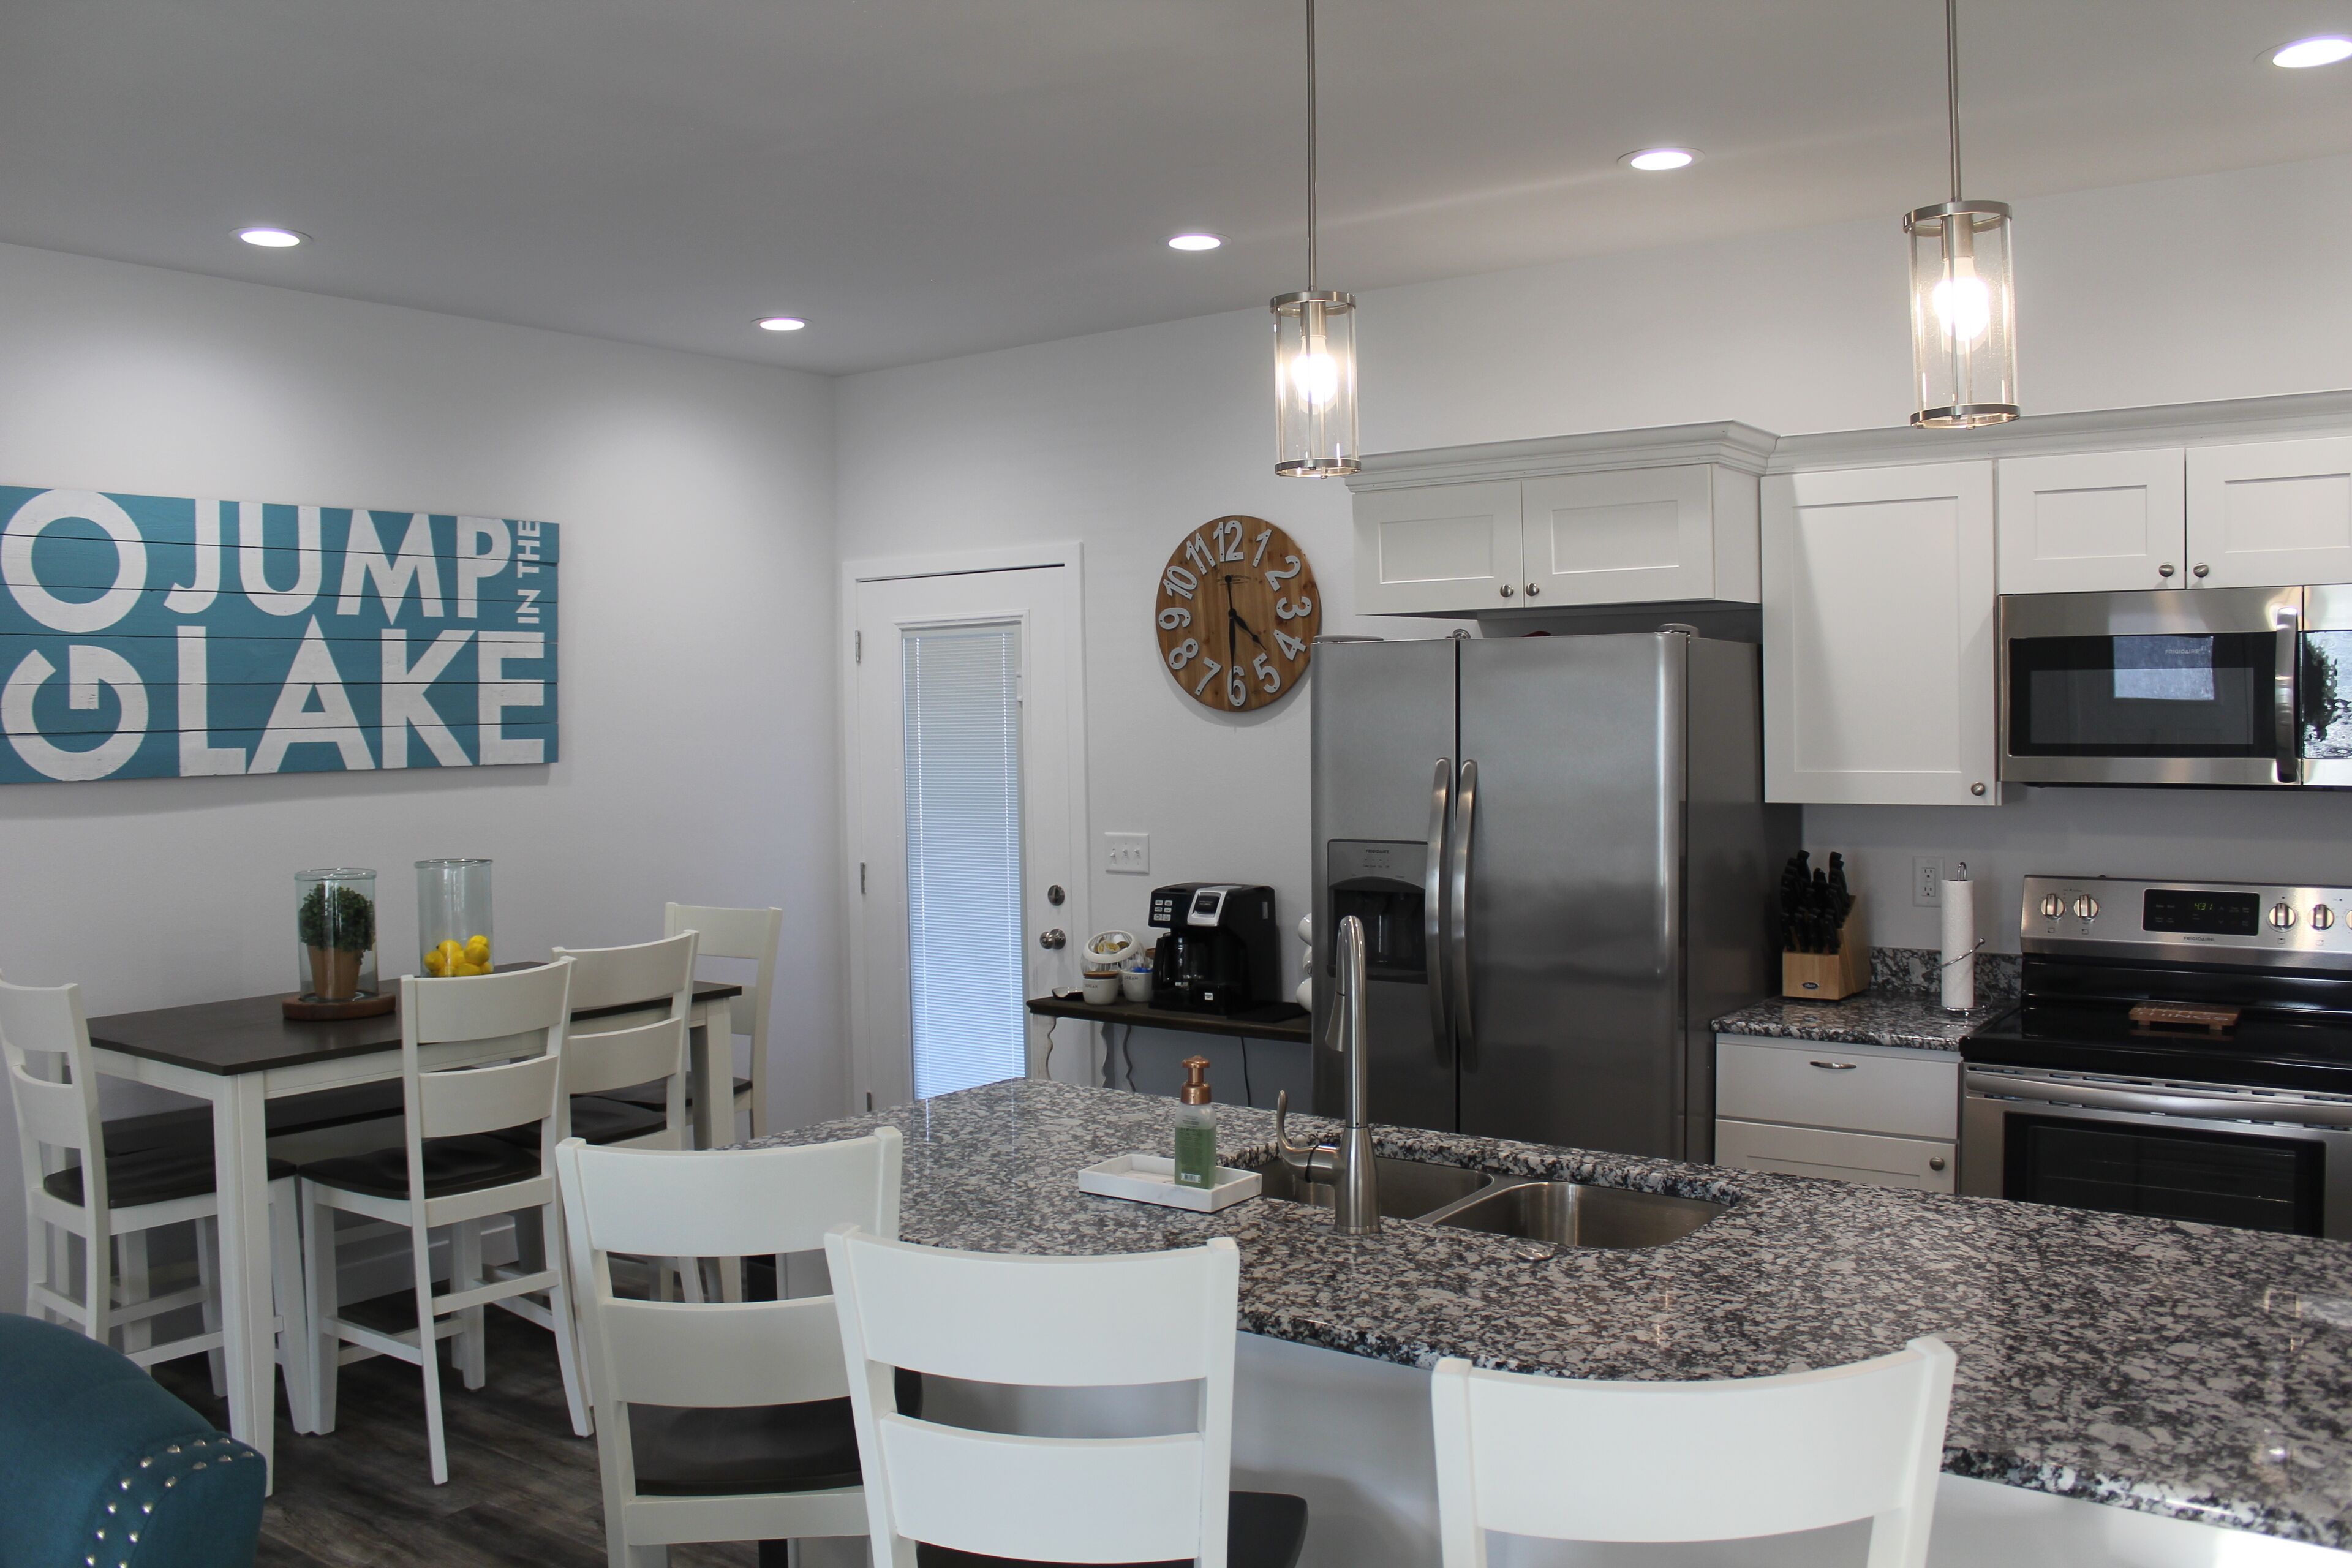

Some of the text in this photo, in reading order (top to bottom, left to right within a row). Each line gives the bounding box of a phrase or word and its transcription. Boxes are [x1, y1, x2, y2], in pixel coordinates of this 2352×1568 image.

[1185, 532, 1217, 575] 11
[1213, 520, 1245, 562] 12
[1252, 529, 1272, 568] 1
[164, 499, 512, 625] JUMP
[517, 521, 541, 624] IN THE
[1265, 555, 1302, 592] 2
[1163, 565, 1198, 600] 10
[1158, 606, 1191, 630] 9
[1276, 596, 1312, 620] 3
[1168, 638, 1199, 670] 8
[1273, 628, 1306, 662] 4
[1195, 656, 1222, 696] 7
[1227, 665, 1246, 707] 6
[1253, 652, 1281, 693] 5
[176, 614, 545, 777] LAKE
